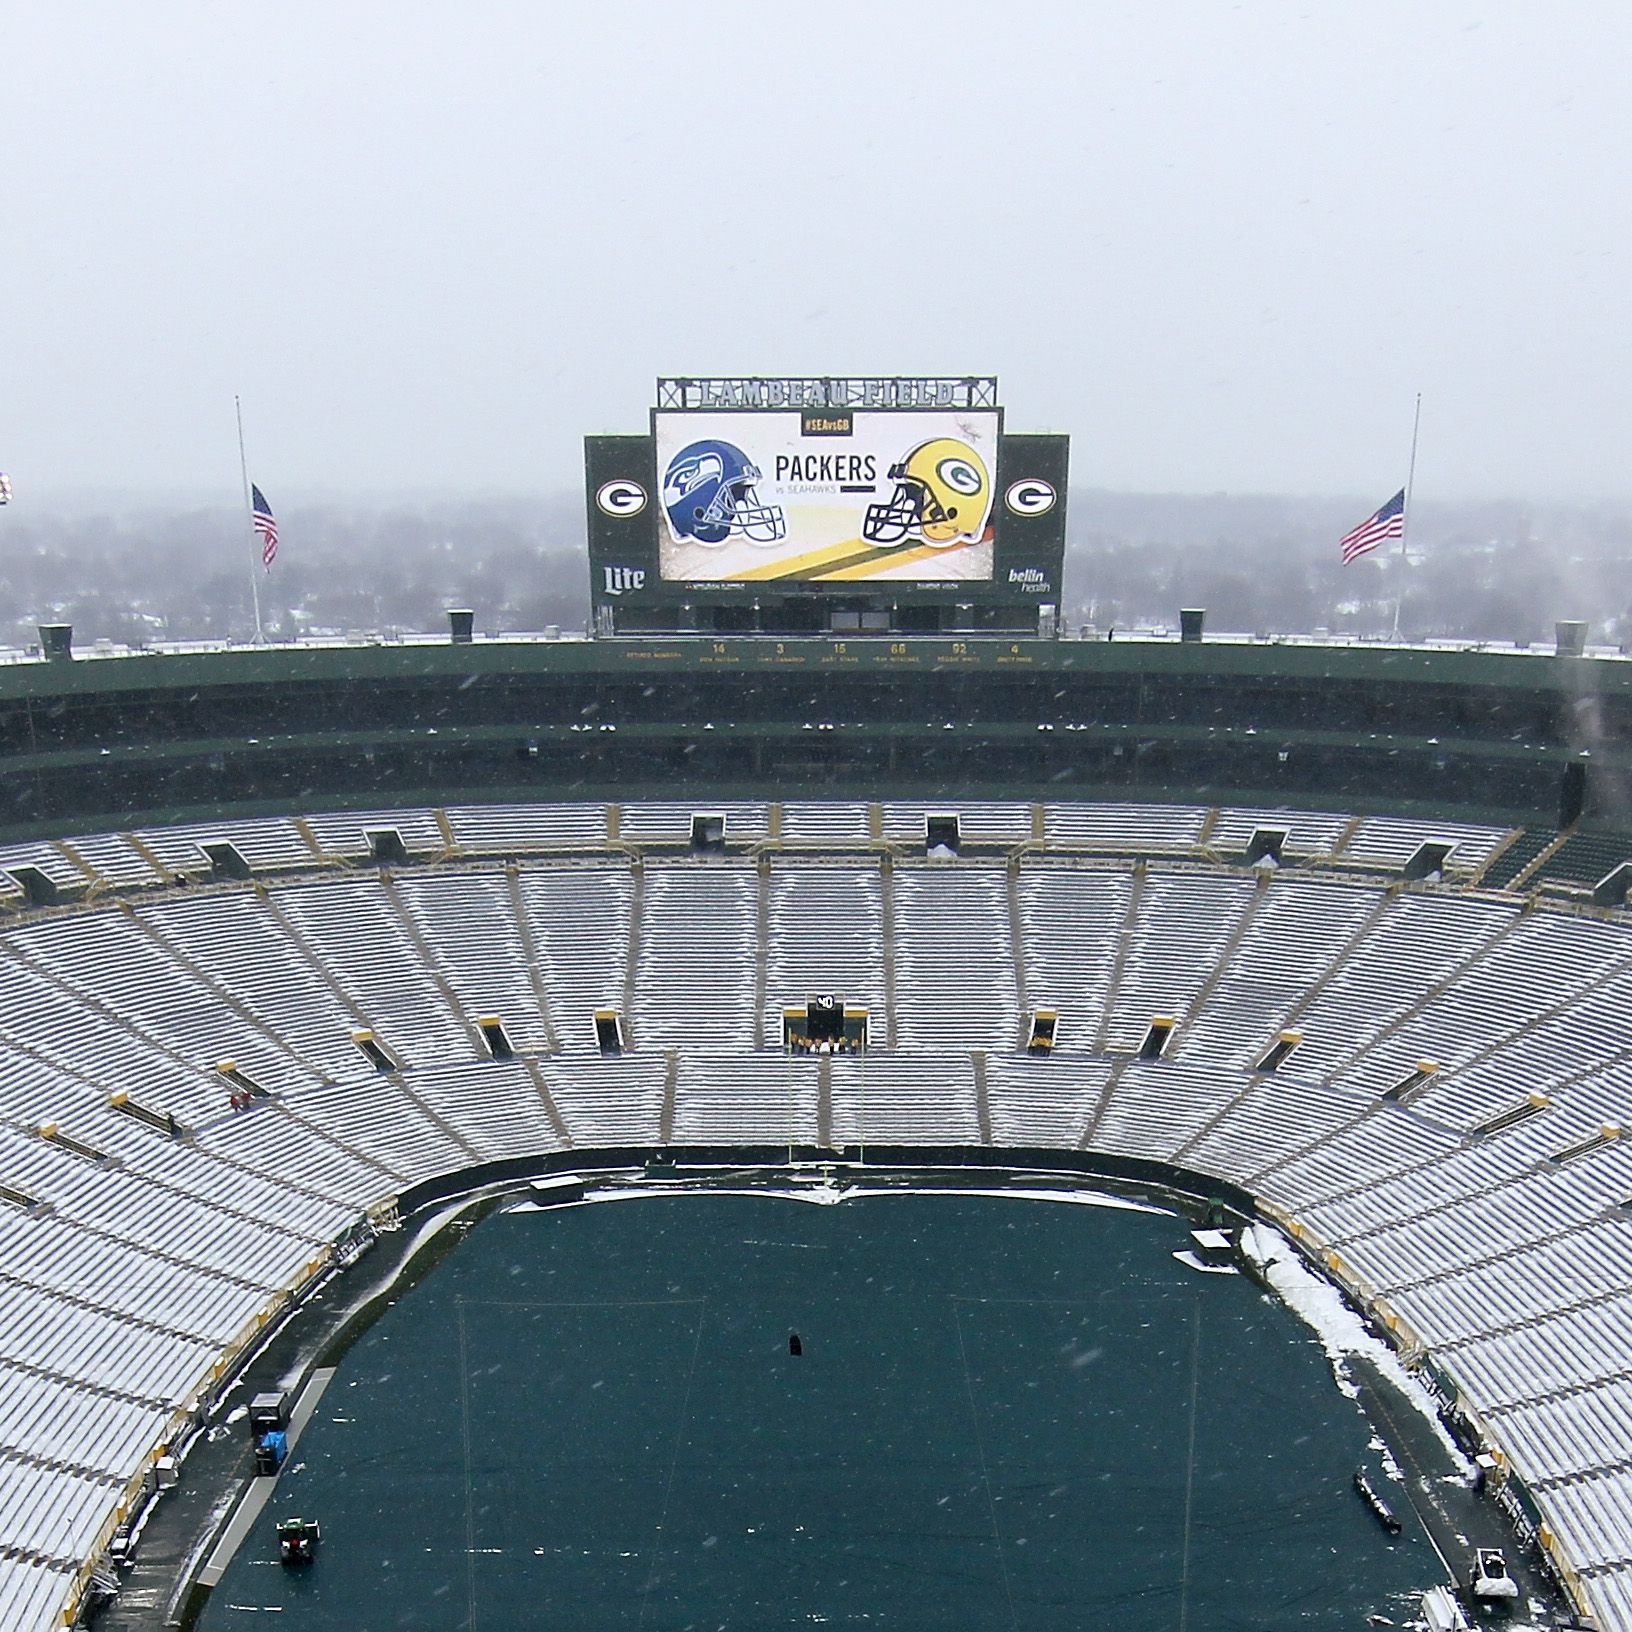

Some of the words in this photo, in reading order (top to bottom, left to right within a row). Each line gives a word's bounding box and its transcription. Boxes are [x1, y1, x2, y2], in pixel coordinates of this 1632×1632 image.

[700, 380, 849, 407] LAMBEAU
[864, 380, 955, 407] FIELD
[805, 418, 850, 432] #SEAvsGB
[776, 454, 877, 483] PACKERS
[788, 485, 837, 494] SEAHAWKS
[604, 567, 645, 596] Lite
[1009, 568, 1045, 583] bellin
[1021, 583, 1051, 593] health
[776, 643, 785, 654] 3
[952, 643, 969, 654] 92
[817, 996, 834, 1009] 40
